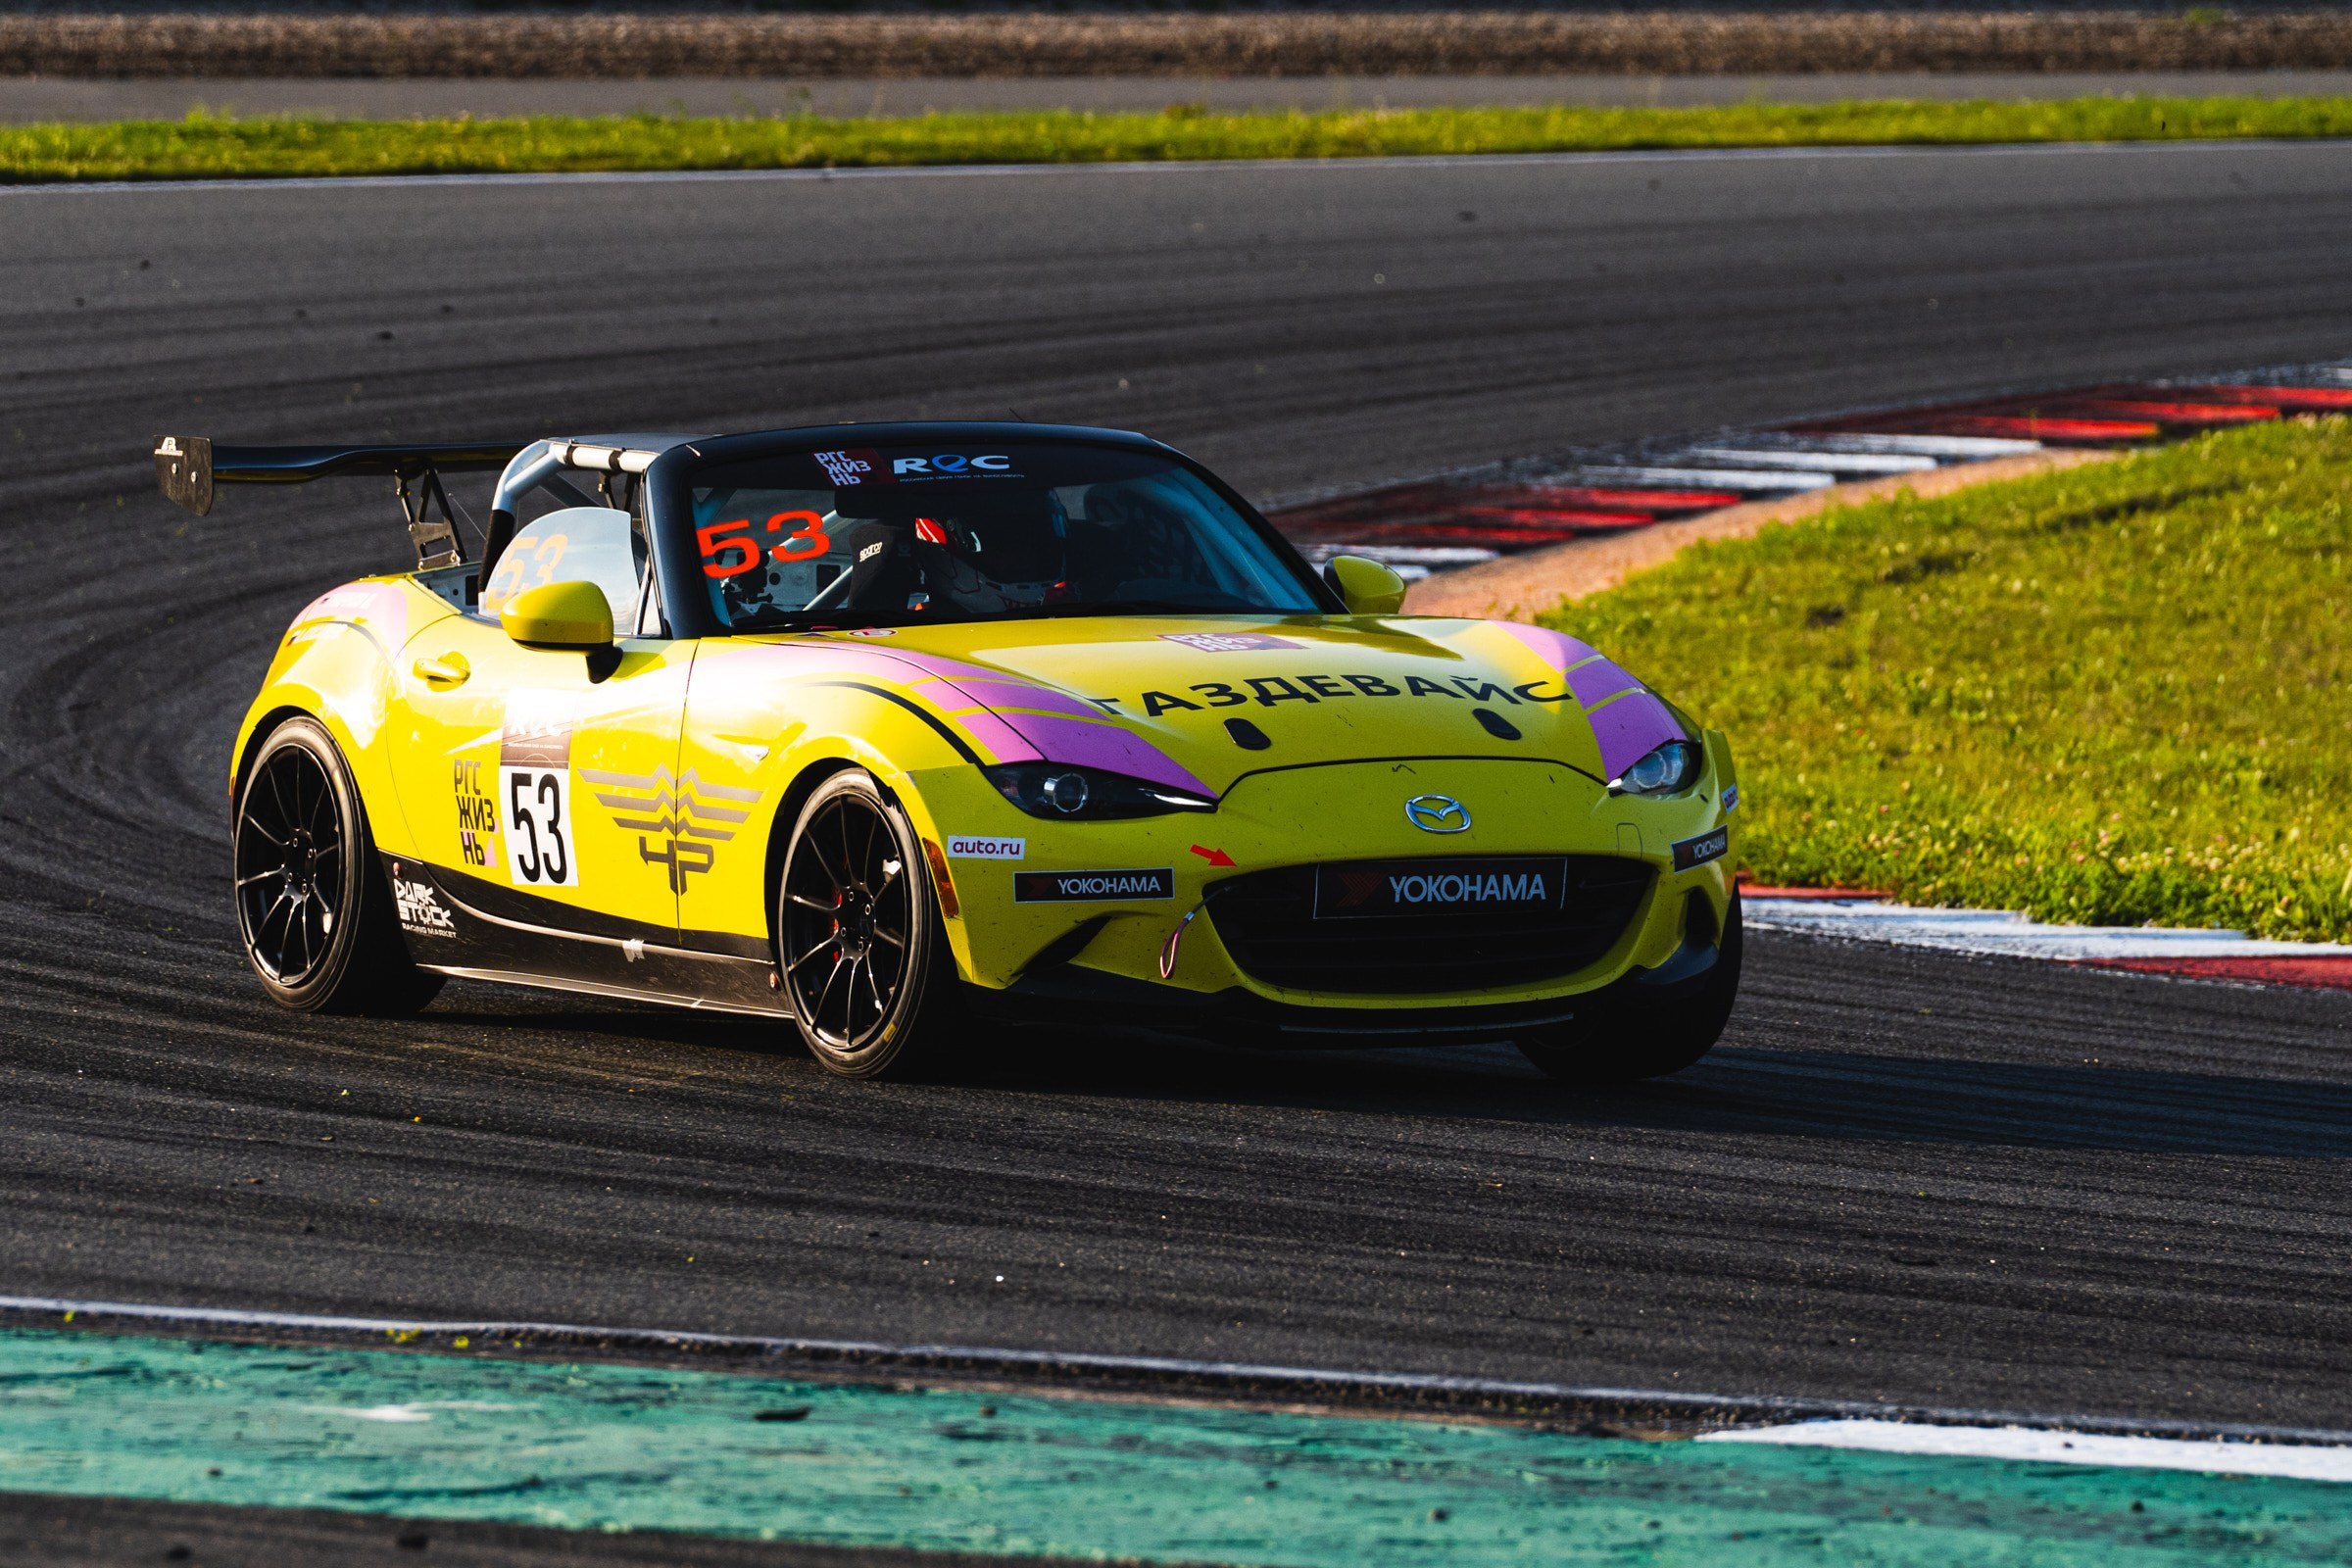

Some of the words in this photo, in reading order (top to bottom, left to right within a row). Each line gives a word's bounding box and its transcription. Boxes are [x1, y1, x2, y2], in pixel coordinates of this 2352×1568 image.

[814, 451, 851, 465] РГС
[823, 461, 871, 474] ЖИЗ
[830, 472, 861, 486] НЬ
[696, 510, 831, 578] 53
[1084, 674, 1572, 716] ГАЗДЕВАЙС
[454, 759, 481, 796] РГС
[456, 795, 495, 832] ЖИЗ
[511, 772, 567, 884] 53
[461, 831, 486, 866] НЬ
[953, 840, 1020, 856] auto.ru
[1692, 833, 1726, 860] YOKOHAMA
[394, 878, 437, 906] DARK
[1057, 876, 1161, 895] YOKOHAMA
[1389, 873, 1546, 903] YOKOHAMA
[397, 899, 455, 928] STOCK
[402, 922, 427, 934] RACING
[427, 927, 457, 938] MARKET
